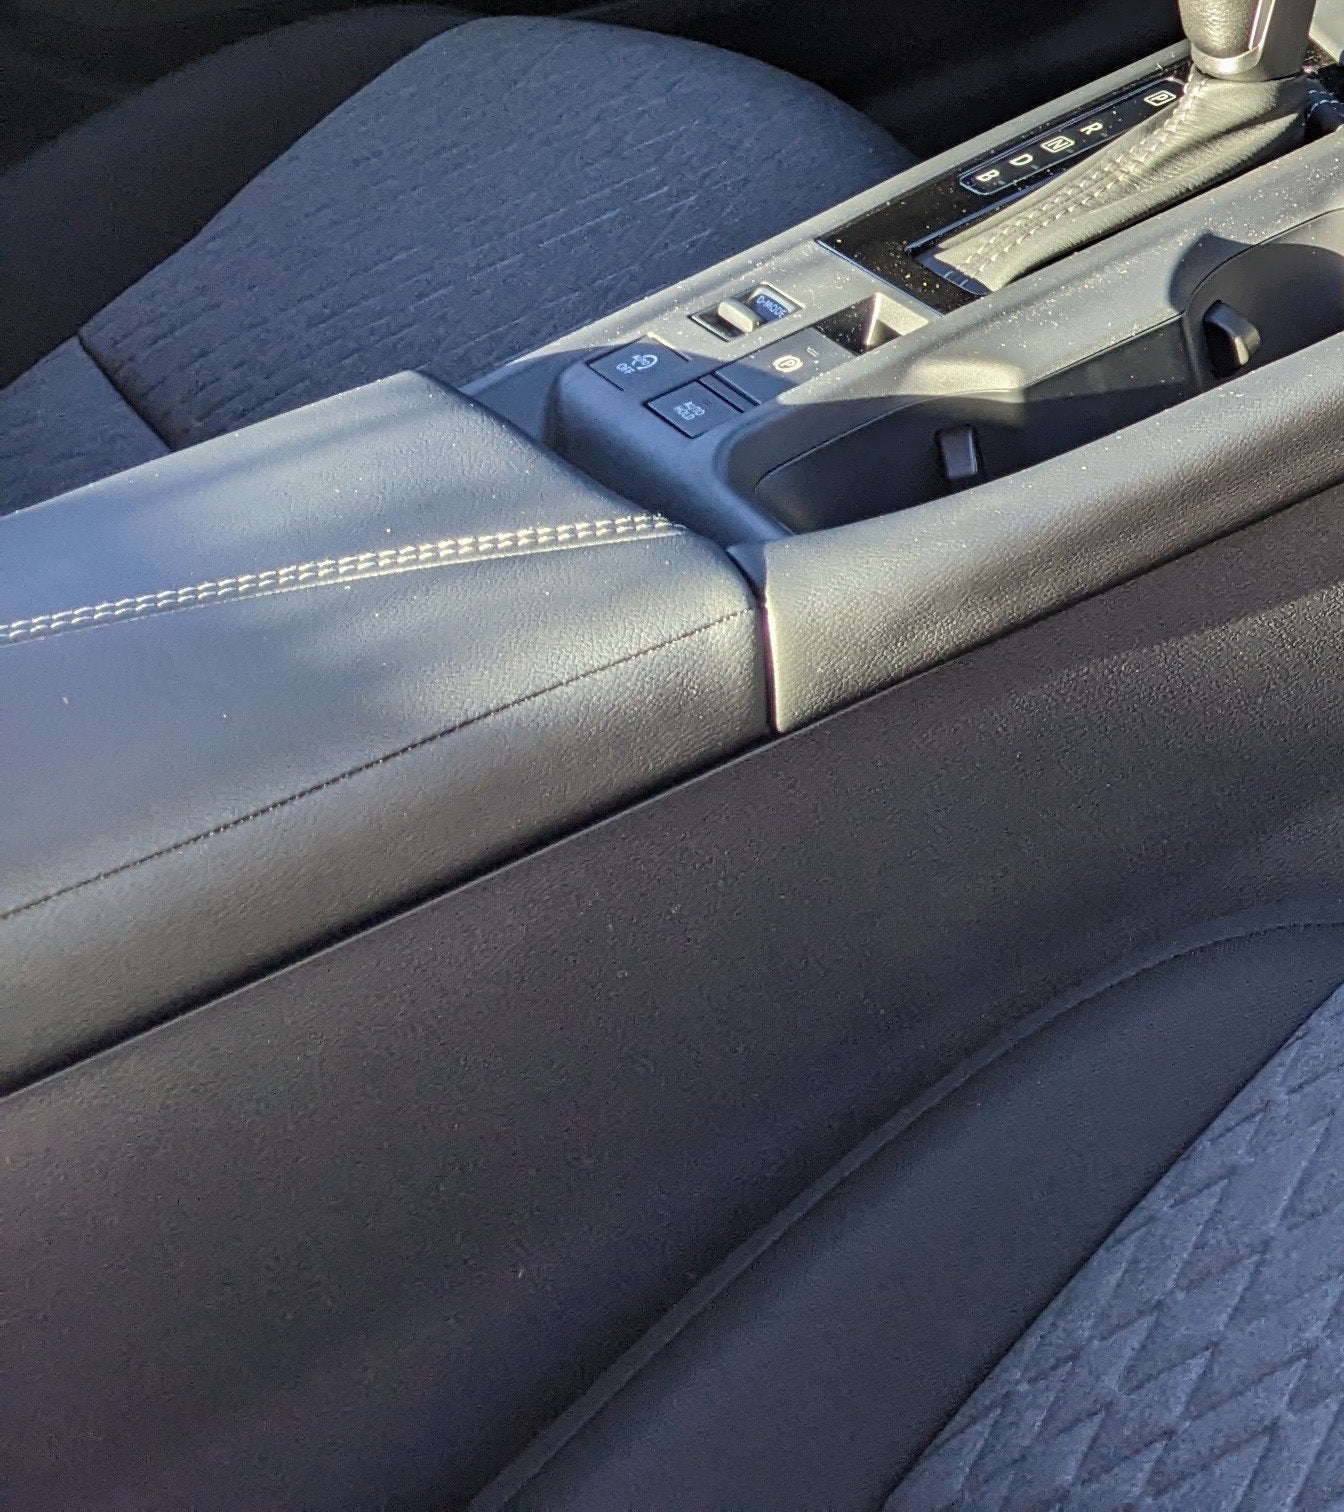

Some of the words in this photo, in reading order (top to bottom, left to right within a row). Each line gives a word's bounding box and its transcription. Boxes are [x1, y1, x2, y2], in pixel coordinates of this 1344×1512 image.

[1079, 122, 1103, 135] R
[1009, 153, 1034, 167] D
[756, 293, 789, 319] D-MODE
